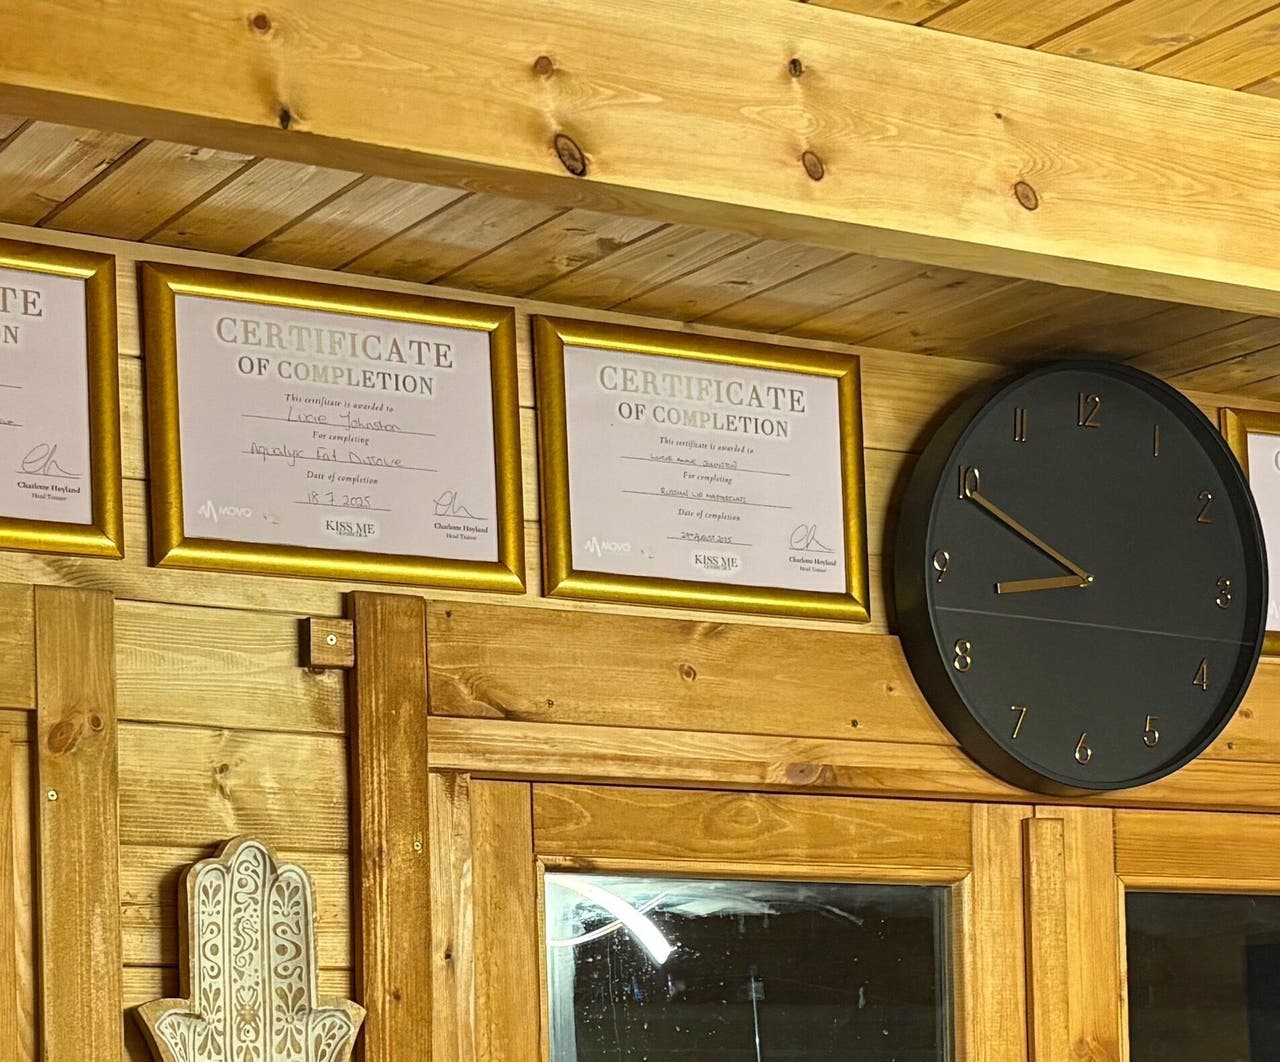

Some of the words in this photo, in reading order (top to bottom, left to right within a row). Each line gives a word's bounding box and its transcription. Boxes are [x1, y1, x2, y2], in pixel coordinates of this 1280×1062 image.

[216, 316, 453, 368] CERTIFICATE
[237, 355, 270, 375] OF
[277, 360, 434, 395] COMPLETION
[600, 366, 806, 413] CERTIFICATE
[284, 394, 301, 403] This
[304, 396, 341, 409] certificate
[352, 403, 384, 413] awarded
[618, 401, 646, 420] OF
[653, 405, 788, 438] COMPLETION
[1078, 392, 1101, 428] 12
[312, 431, 326, 440] For
[328, 434, 370, 446] completing
[1014, 407, 1029, 442] 11
[1153, 424, 1160, 457] 1
[659, 436, 674, 445] This
[676, 440, 708, 451] certificate
[718, 444, 745, 454] awarded
[306, 470, 326, 480] Date
[327, 471, 337, 483] of
[338, 474, 379, 486] completion
[682, 471, 696, 480] For
[697, 474, 733, 485] completing
[958, 463, 981, 500] 10
[678, 508, 694, 517] Date
[695, 509, 703, 519] of
[704, 512, 741, 522] completion
[1197, 490, 1215, 524] 2
[325, 520, 353, 533] KISS
[356, 523, 376, 535] ME
[695, 554, 719, 566] KISS
[721, 557, 738, 569] ME
[932, 549, 951, 583] 9
[1215, 577, 1233, 609] 3
[953, 639, 973, 672] 8
[1192, 657, 1209, 691] 4
[1010, 704, 1027, 739] 7
[1143, 713, 1161, 747] 5
[1074, 732, 1092, 765] 6
